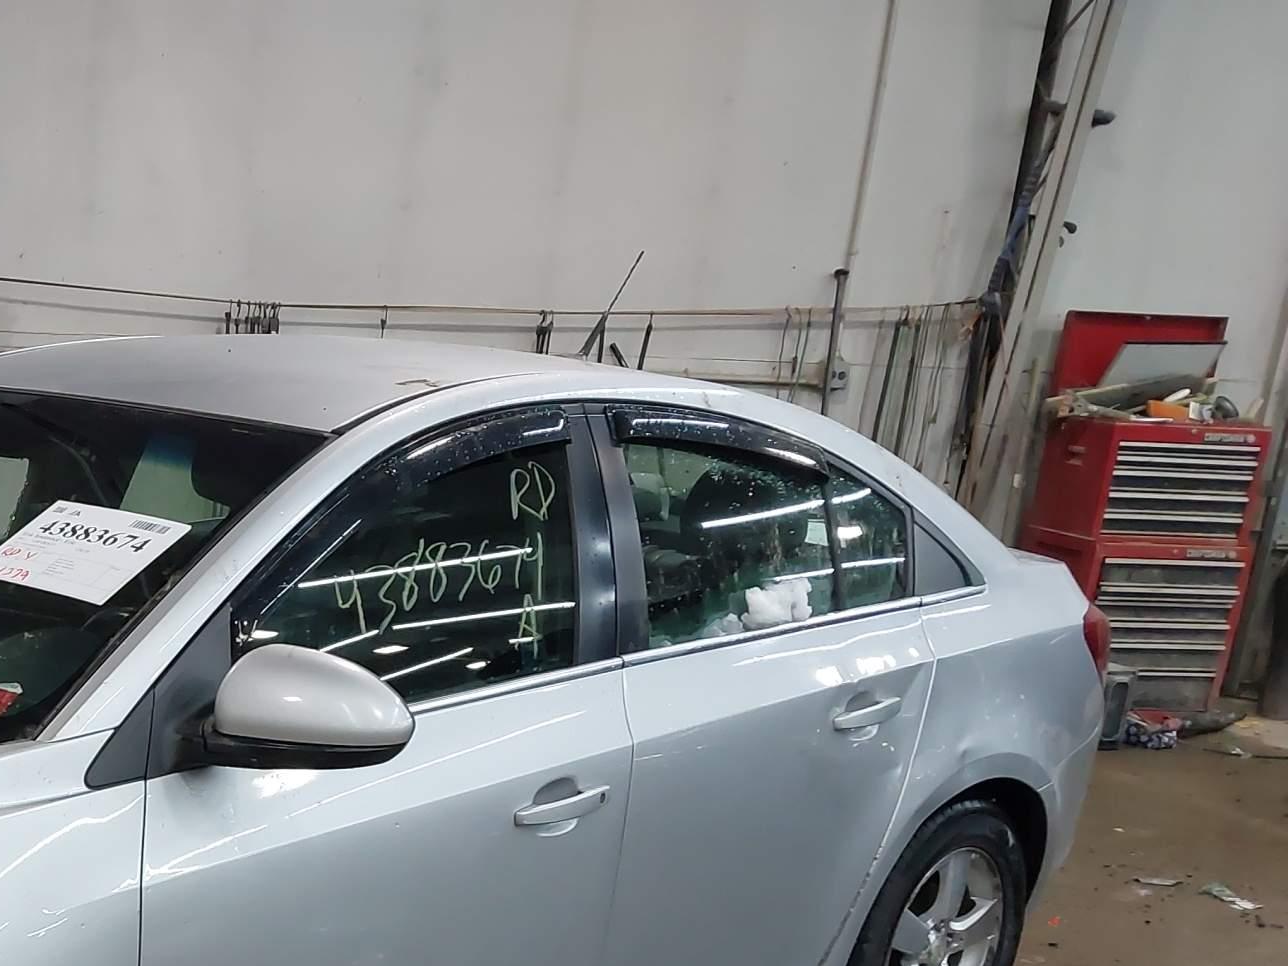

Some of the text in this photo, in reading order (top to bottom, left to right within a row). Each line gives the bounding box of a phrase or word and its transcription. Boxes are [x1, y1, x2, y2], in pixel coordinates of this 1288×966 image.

[509, 460, 556, 521] RD
[40, 520, 152, 552] 43883674
[332, 531, 544, 635] 43883674
